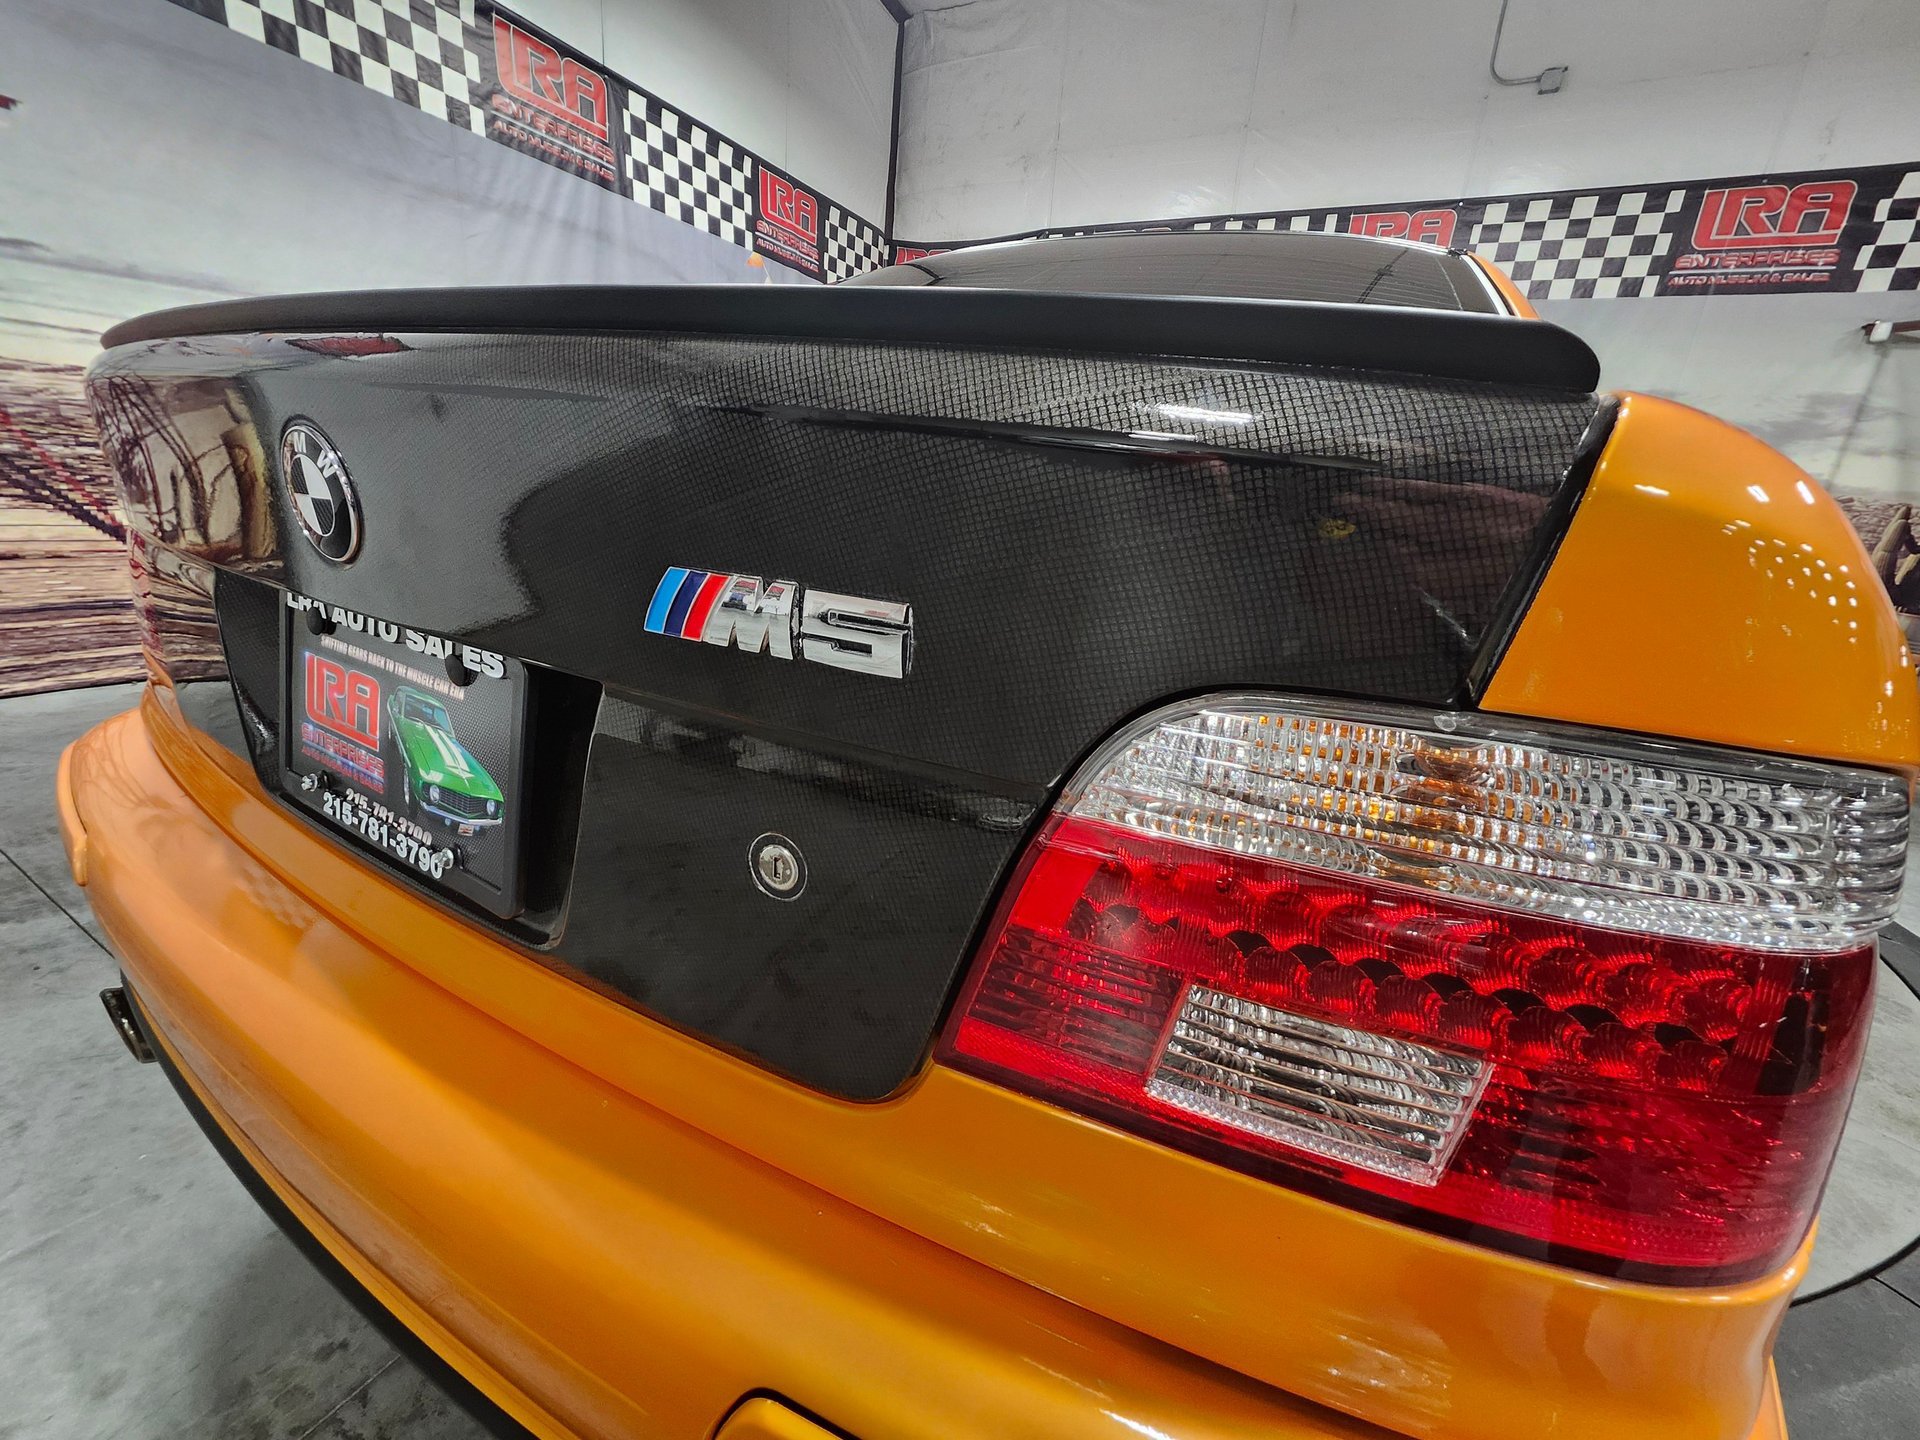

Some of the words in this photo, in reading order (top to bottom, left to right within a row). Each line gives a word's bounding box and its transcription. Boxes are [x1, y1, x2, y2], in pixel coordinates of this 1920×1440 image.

[493, 14, 608, 142] LRA
[491, 94, 615, 164] ENTERPRISES
[756, 219, 819, 260] ENTERPRISES
[759, 165, 817, 245] LRA
[1691, 180, 1858, 250] LRA
[1667, 275, 1707, 286] AUTO
[1675, 249, 1841, 269] ENTERPRISES
[286, 431, 337, 478] MW
[702, 575, 913, 679] M5
[305, 652, 380, 752] LRA
[302, 722, 385, 778] ENTERPRISES
